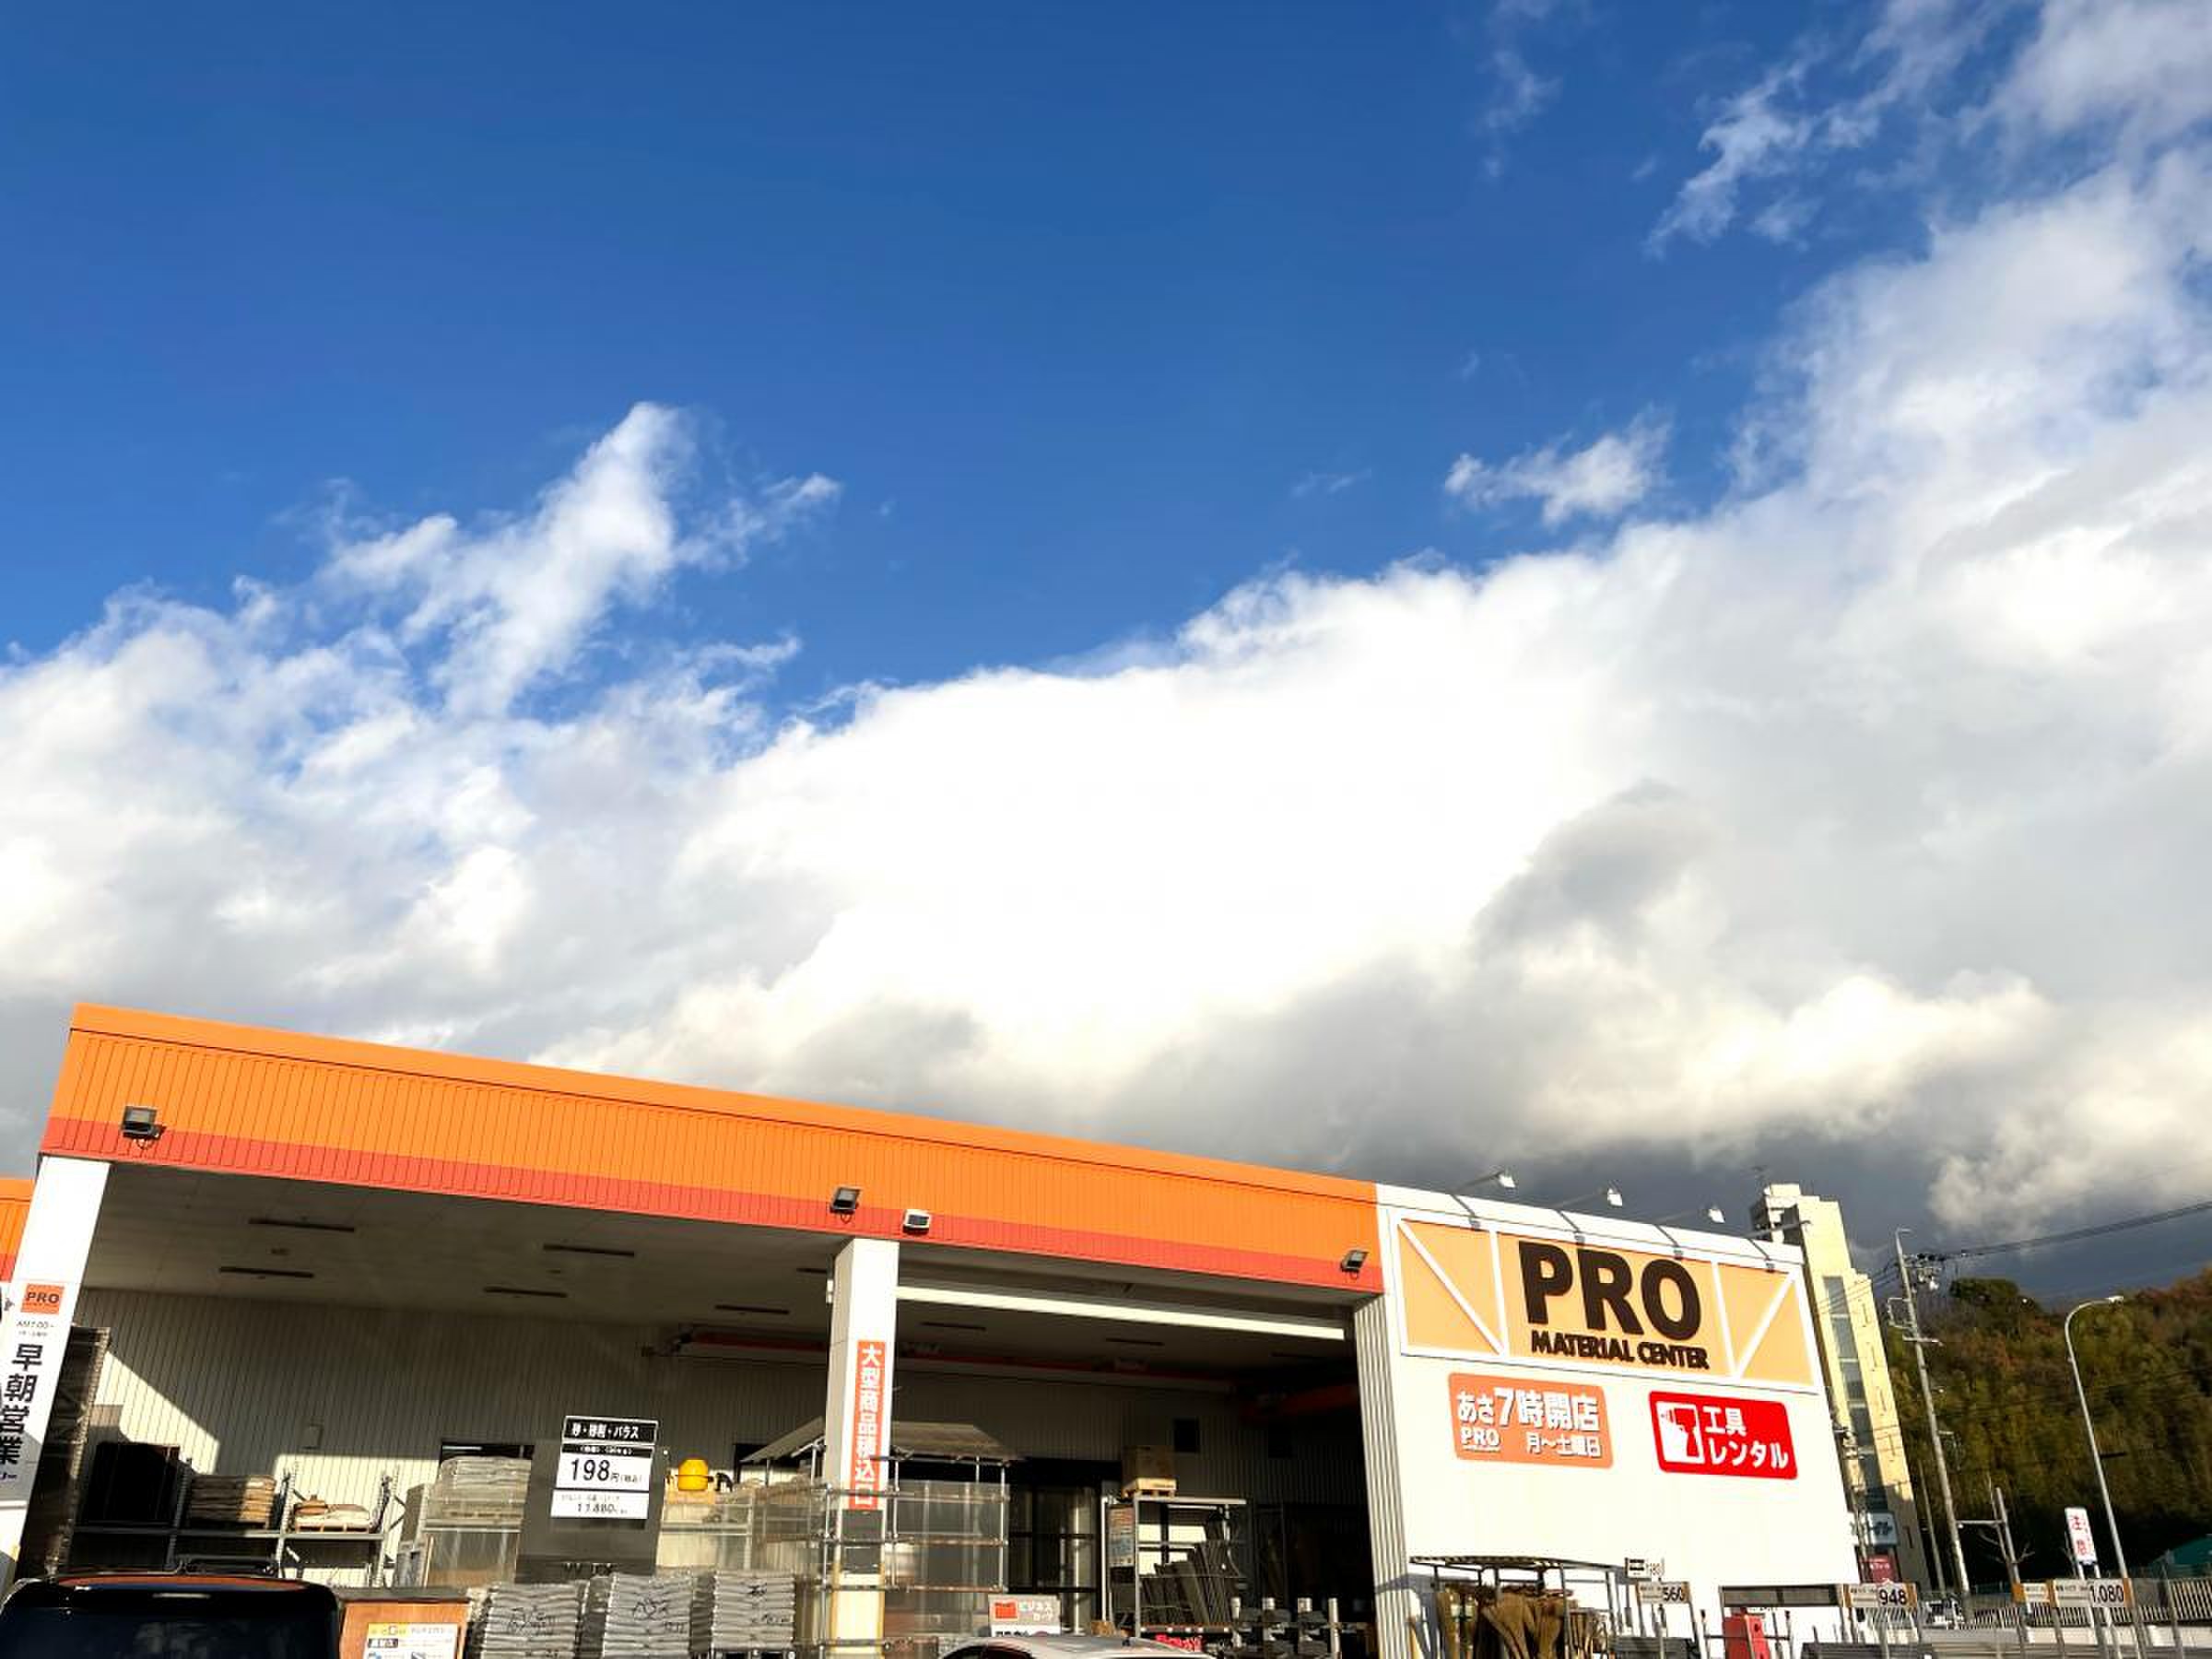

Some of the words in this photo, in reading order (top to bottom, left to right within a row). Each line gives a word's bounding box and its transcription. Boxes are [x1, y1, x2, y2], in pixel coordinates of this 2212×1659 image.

[25, 1292, 60, 1304] PRO
[1519, 1241, 1701, 1341] PRO
[1531, 1330, 1636, 1361] MATERIAL
[1637, 1341, 1710, 1370] CENTER
[854, 1343, 883, 1505] 大型商品積込口
[1456, 1386, 1601, 1431] あさ7時開店
[1702, 1405, 1747, 1437] 工具
[1460, 1426, 1501, 1447] PRO
[1708, 1437, 1790, 1469] レンタル
[1879, 1588, 1907, 1606] 948
